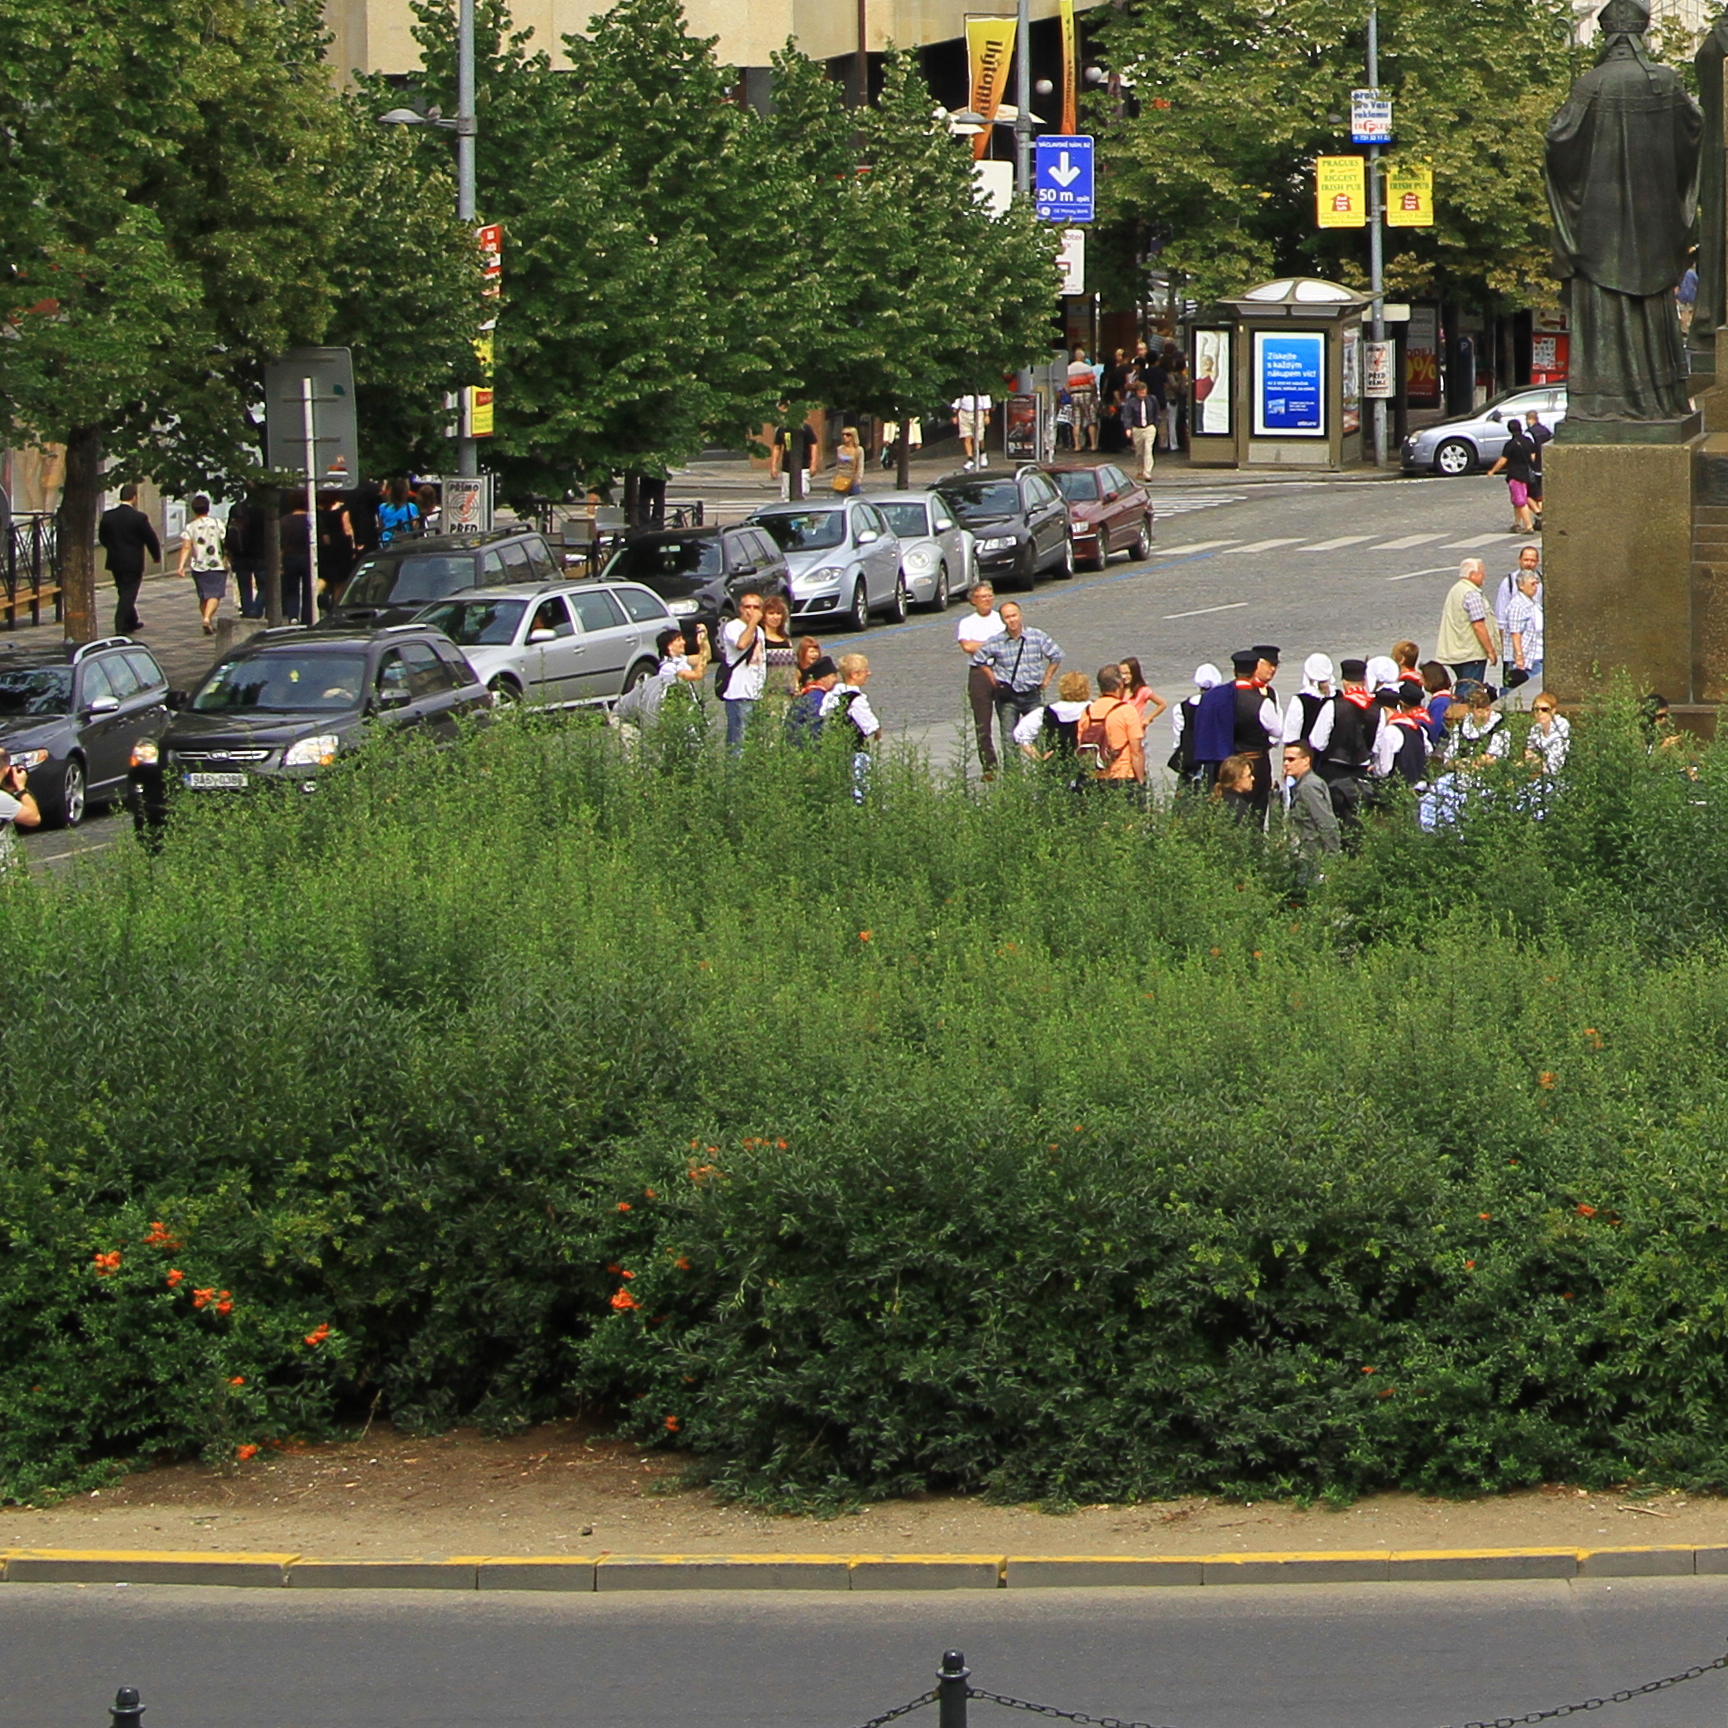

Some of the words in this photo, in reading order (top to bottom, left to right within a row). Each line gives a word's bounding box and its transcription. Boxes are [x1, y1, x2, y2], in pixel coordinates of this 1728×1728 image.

[1038, 189, 1057, 202] 50
[1059, 191, 1074, 202] m
[1063, 233, 1083, 241] otel
